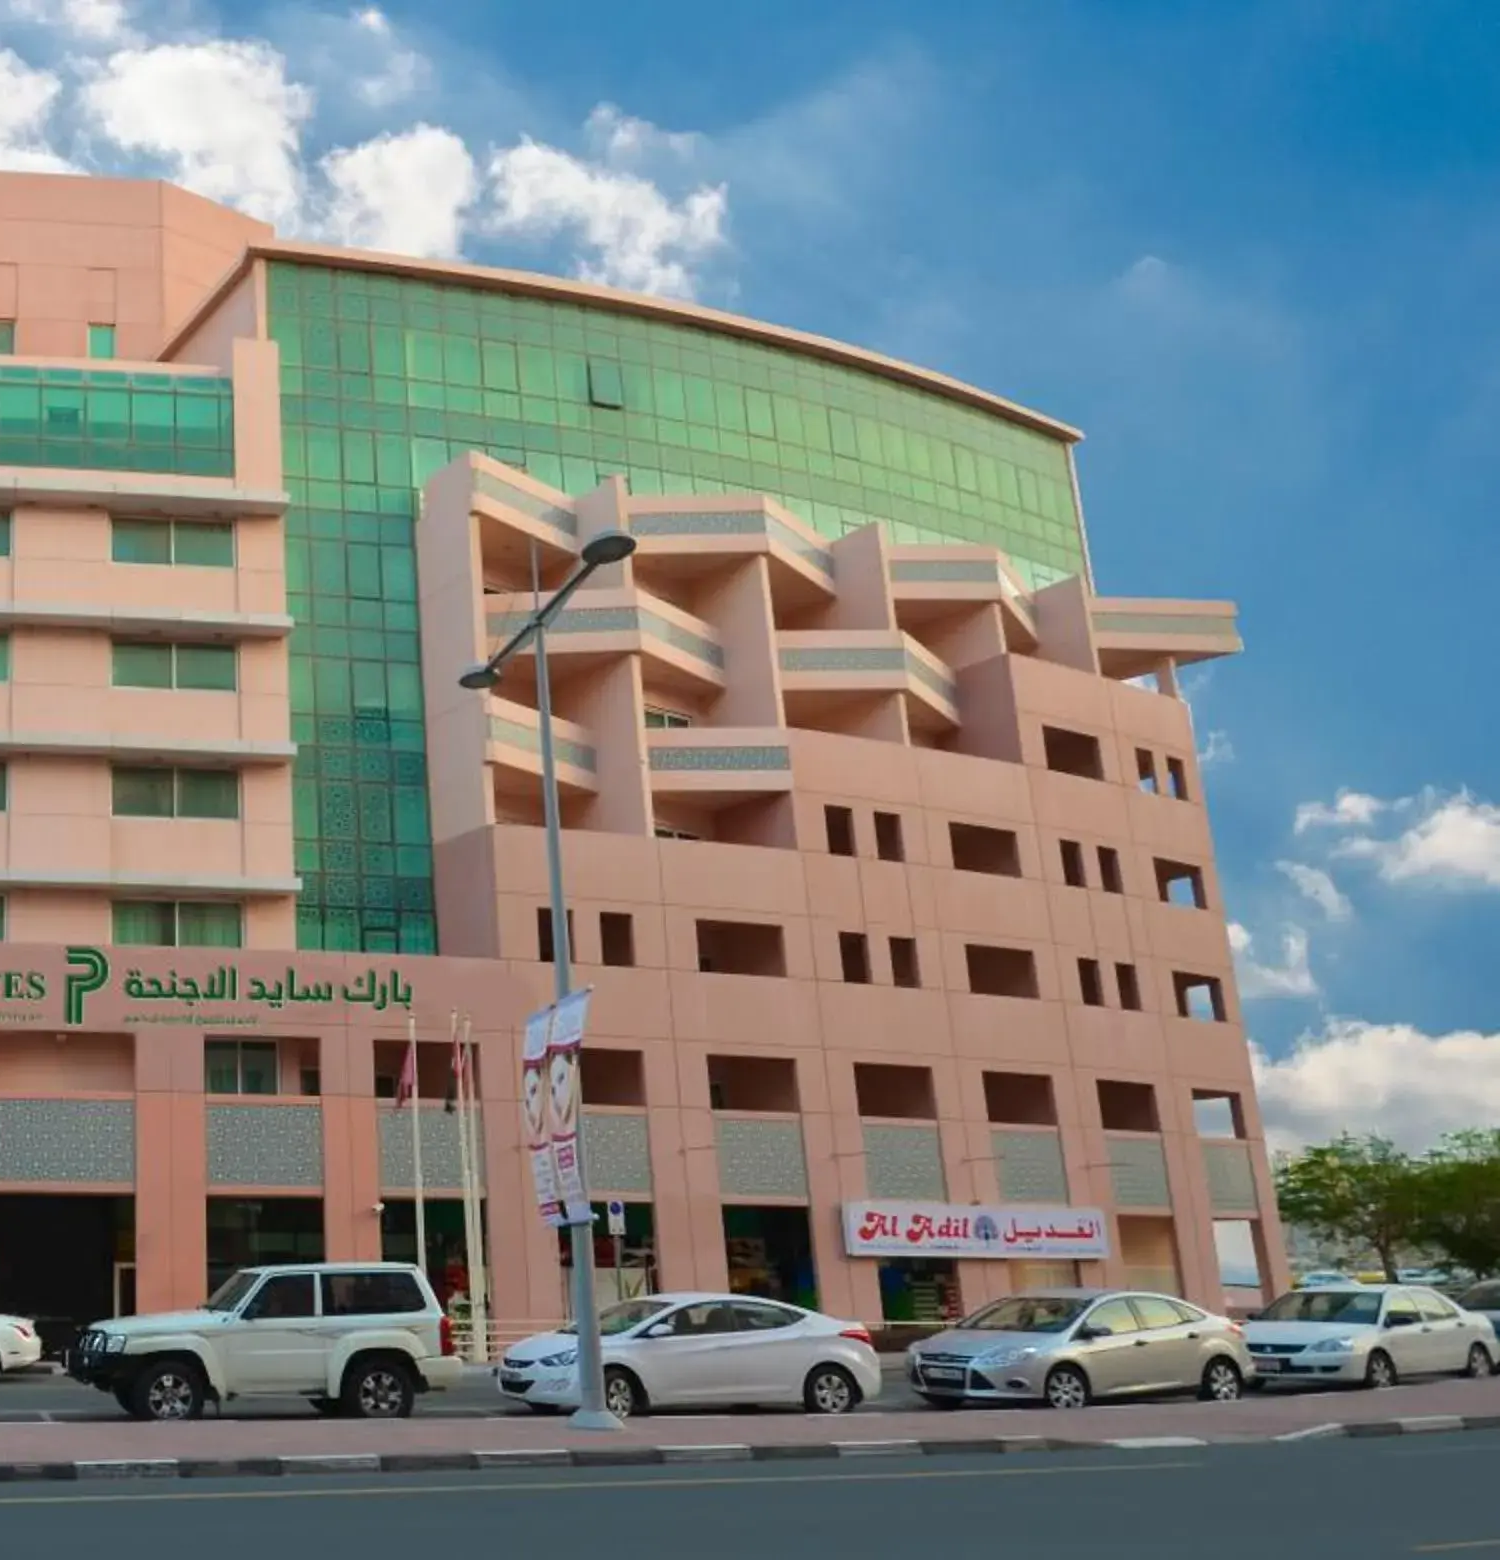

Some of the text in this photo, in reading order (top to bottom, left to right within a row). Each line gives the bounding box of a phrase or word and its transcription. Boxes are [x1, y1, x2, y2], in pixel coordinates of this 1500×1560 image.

[125, 965, 412, 1010] بارك سايد الاجنحة
[858, 1211, 971, 1243] Al Adil
